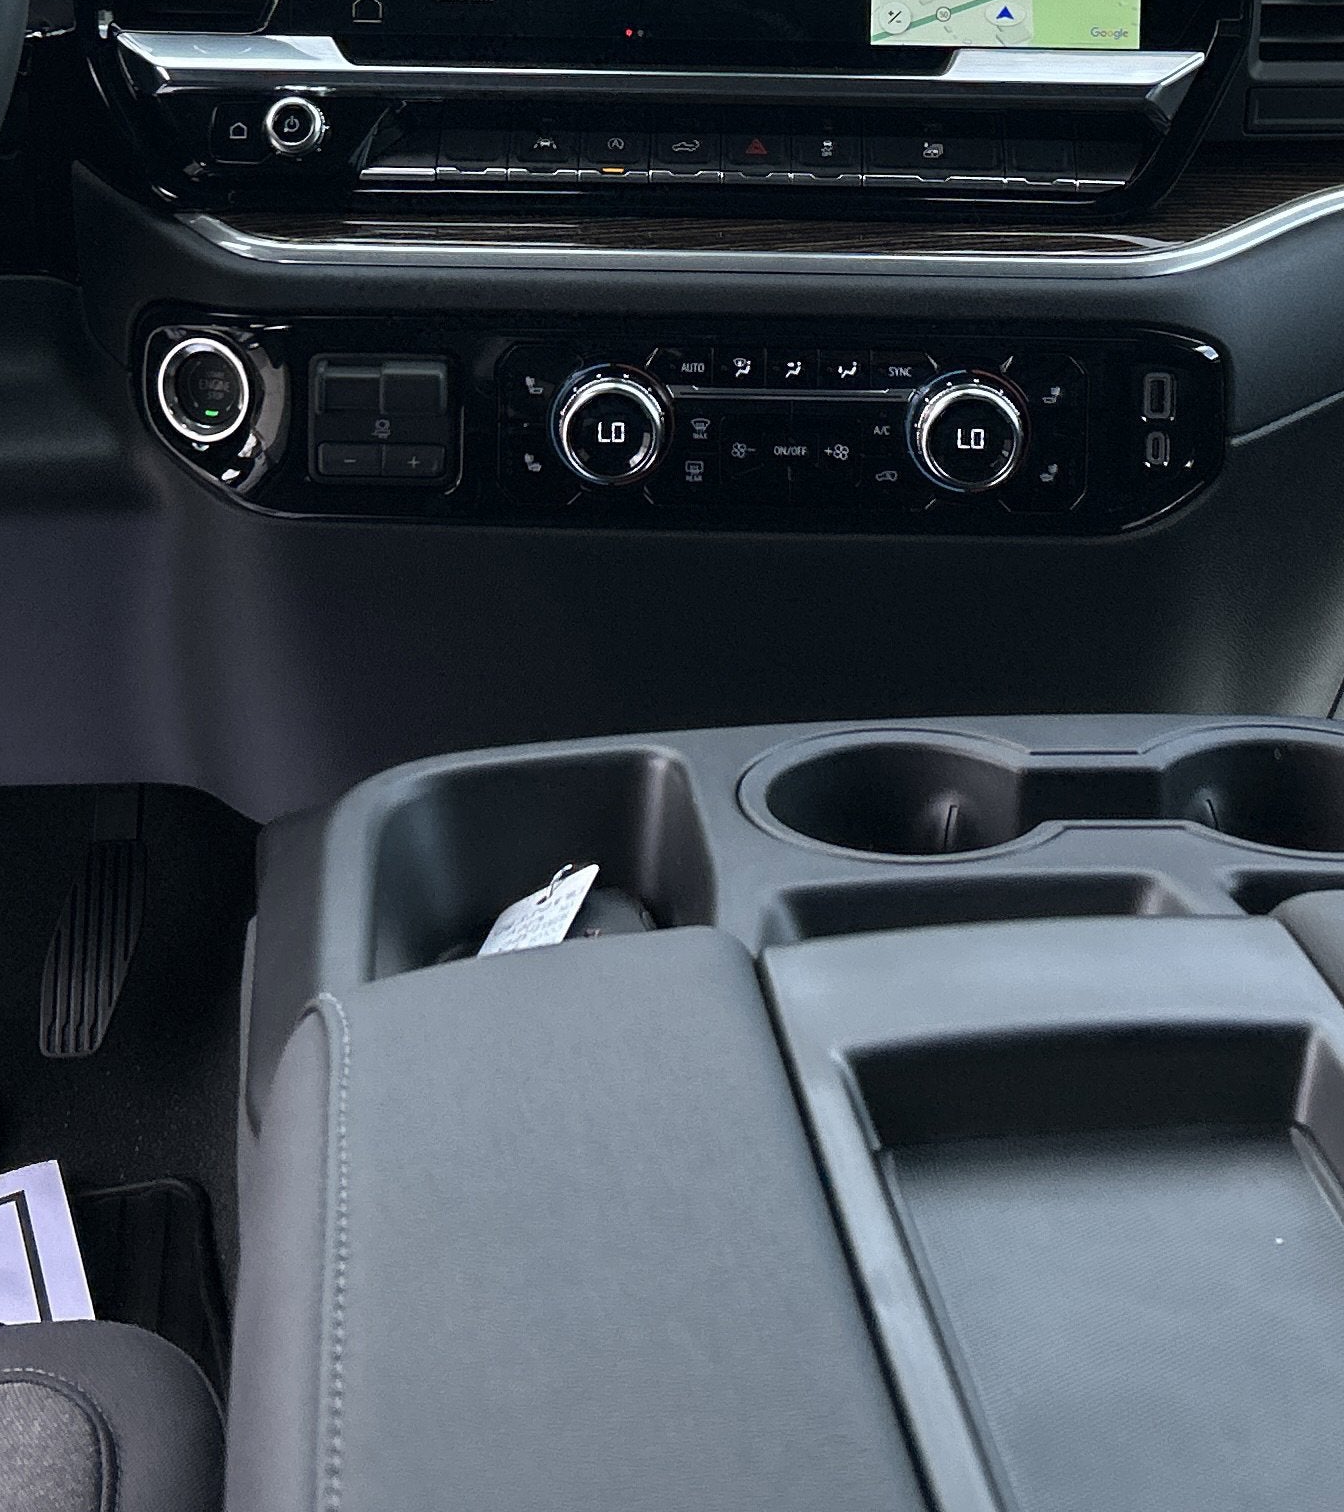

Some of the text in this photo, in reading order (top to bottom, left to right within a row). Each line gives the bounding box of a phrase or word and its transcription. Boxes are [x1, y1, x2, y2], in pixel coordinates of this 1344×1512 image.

[1090, 26, 1129, 40] Google
[680, 362, 705, 373] AUTO
[887, 367, 912, 378] SYNC
[873, 425, 891, 436] A/C
[773, 446, 807, 457] ON/OFF
